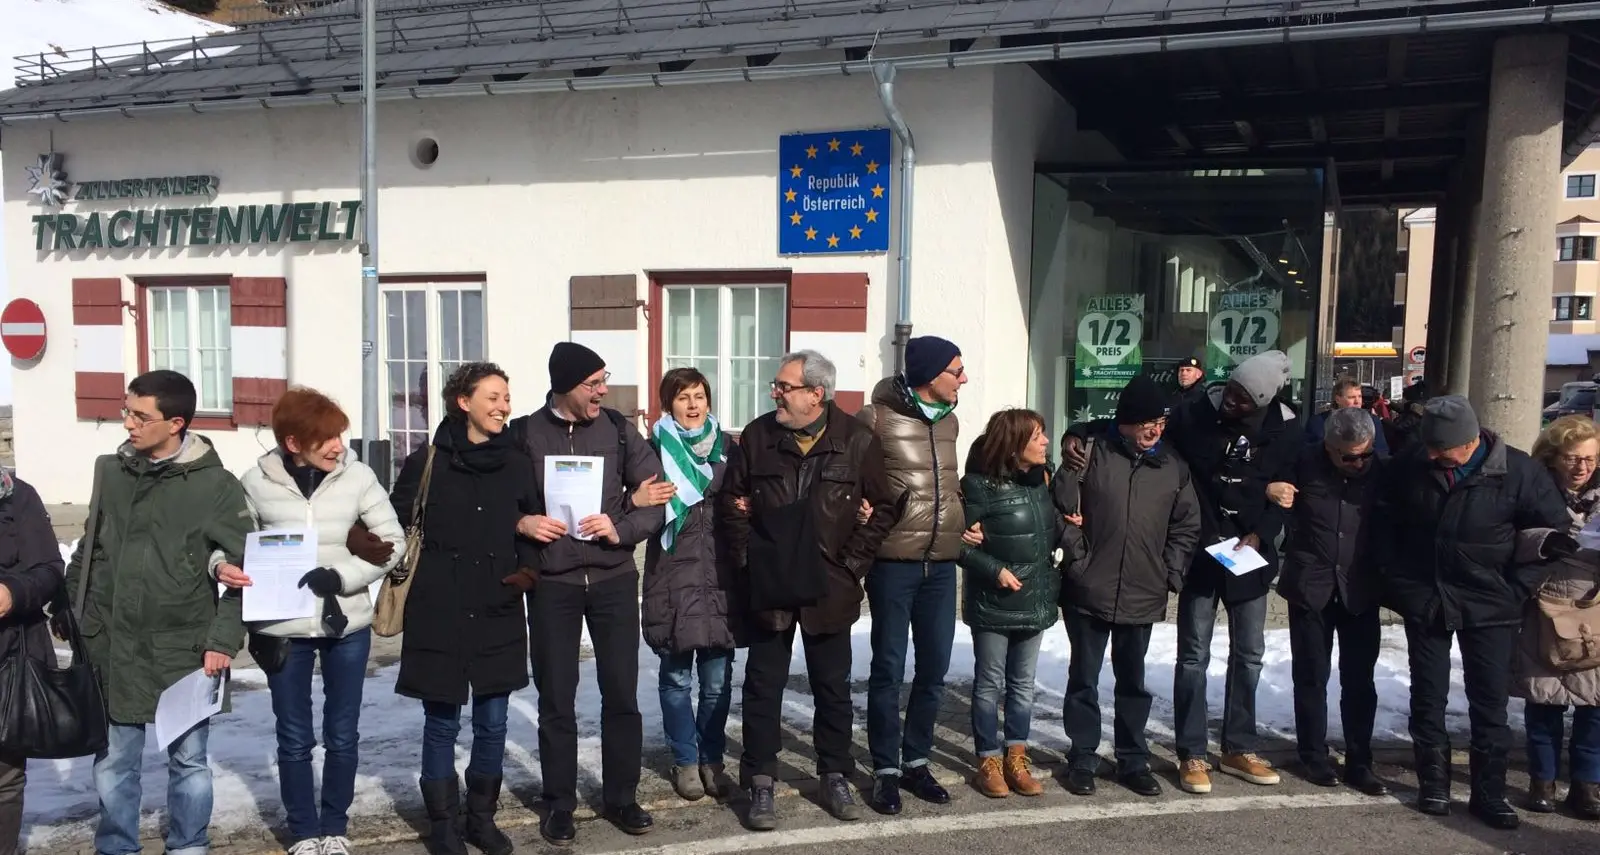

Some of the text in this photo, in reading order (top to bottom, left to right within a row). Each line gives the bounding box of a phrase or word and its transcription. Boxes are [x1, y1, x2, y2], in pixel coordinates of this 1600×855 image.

[74, 175, 213, 200] ZILLERTALER
[808, 173, 860, 193] Republik
[802, 194, 866, 212] Österreich
[32, 200, 362, 251] TRACHTENWELT
[1087, 296, 1132, 311] ALLES
[1219, 292, 1268, 308] ALLES
[1088, 319, 1130, 346] 1/2
[1221, 316, 1267, 344] 1/2
[1096, 346, 1122, 356] PREIS
[1229, 345, 1258, 355] PREIS
